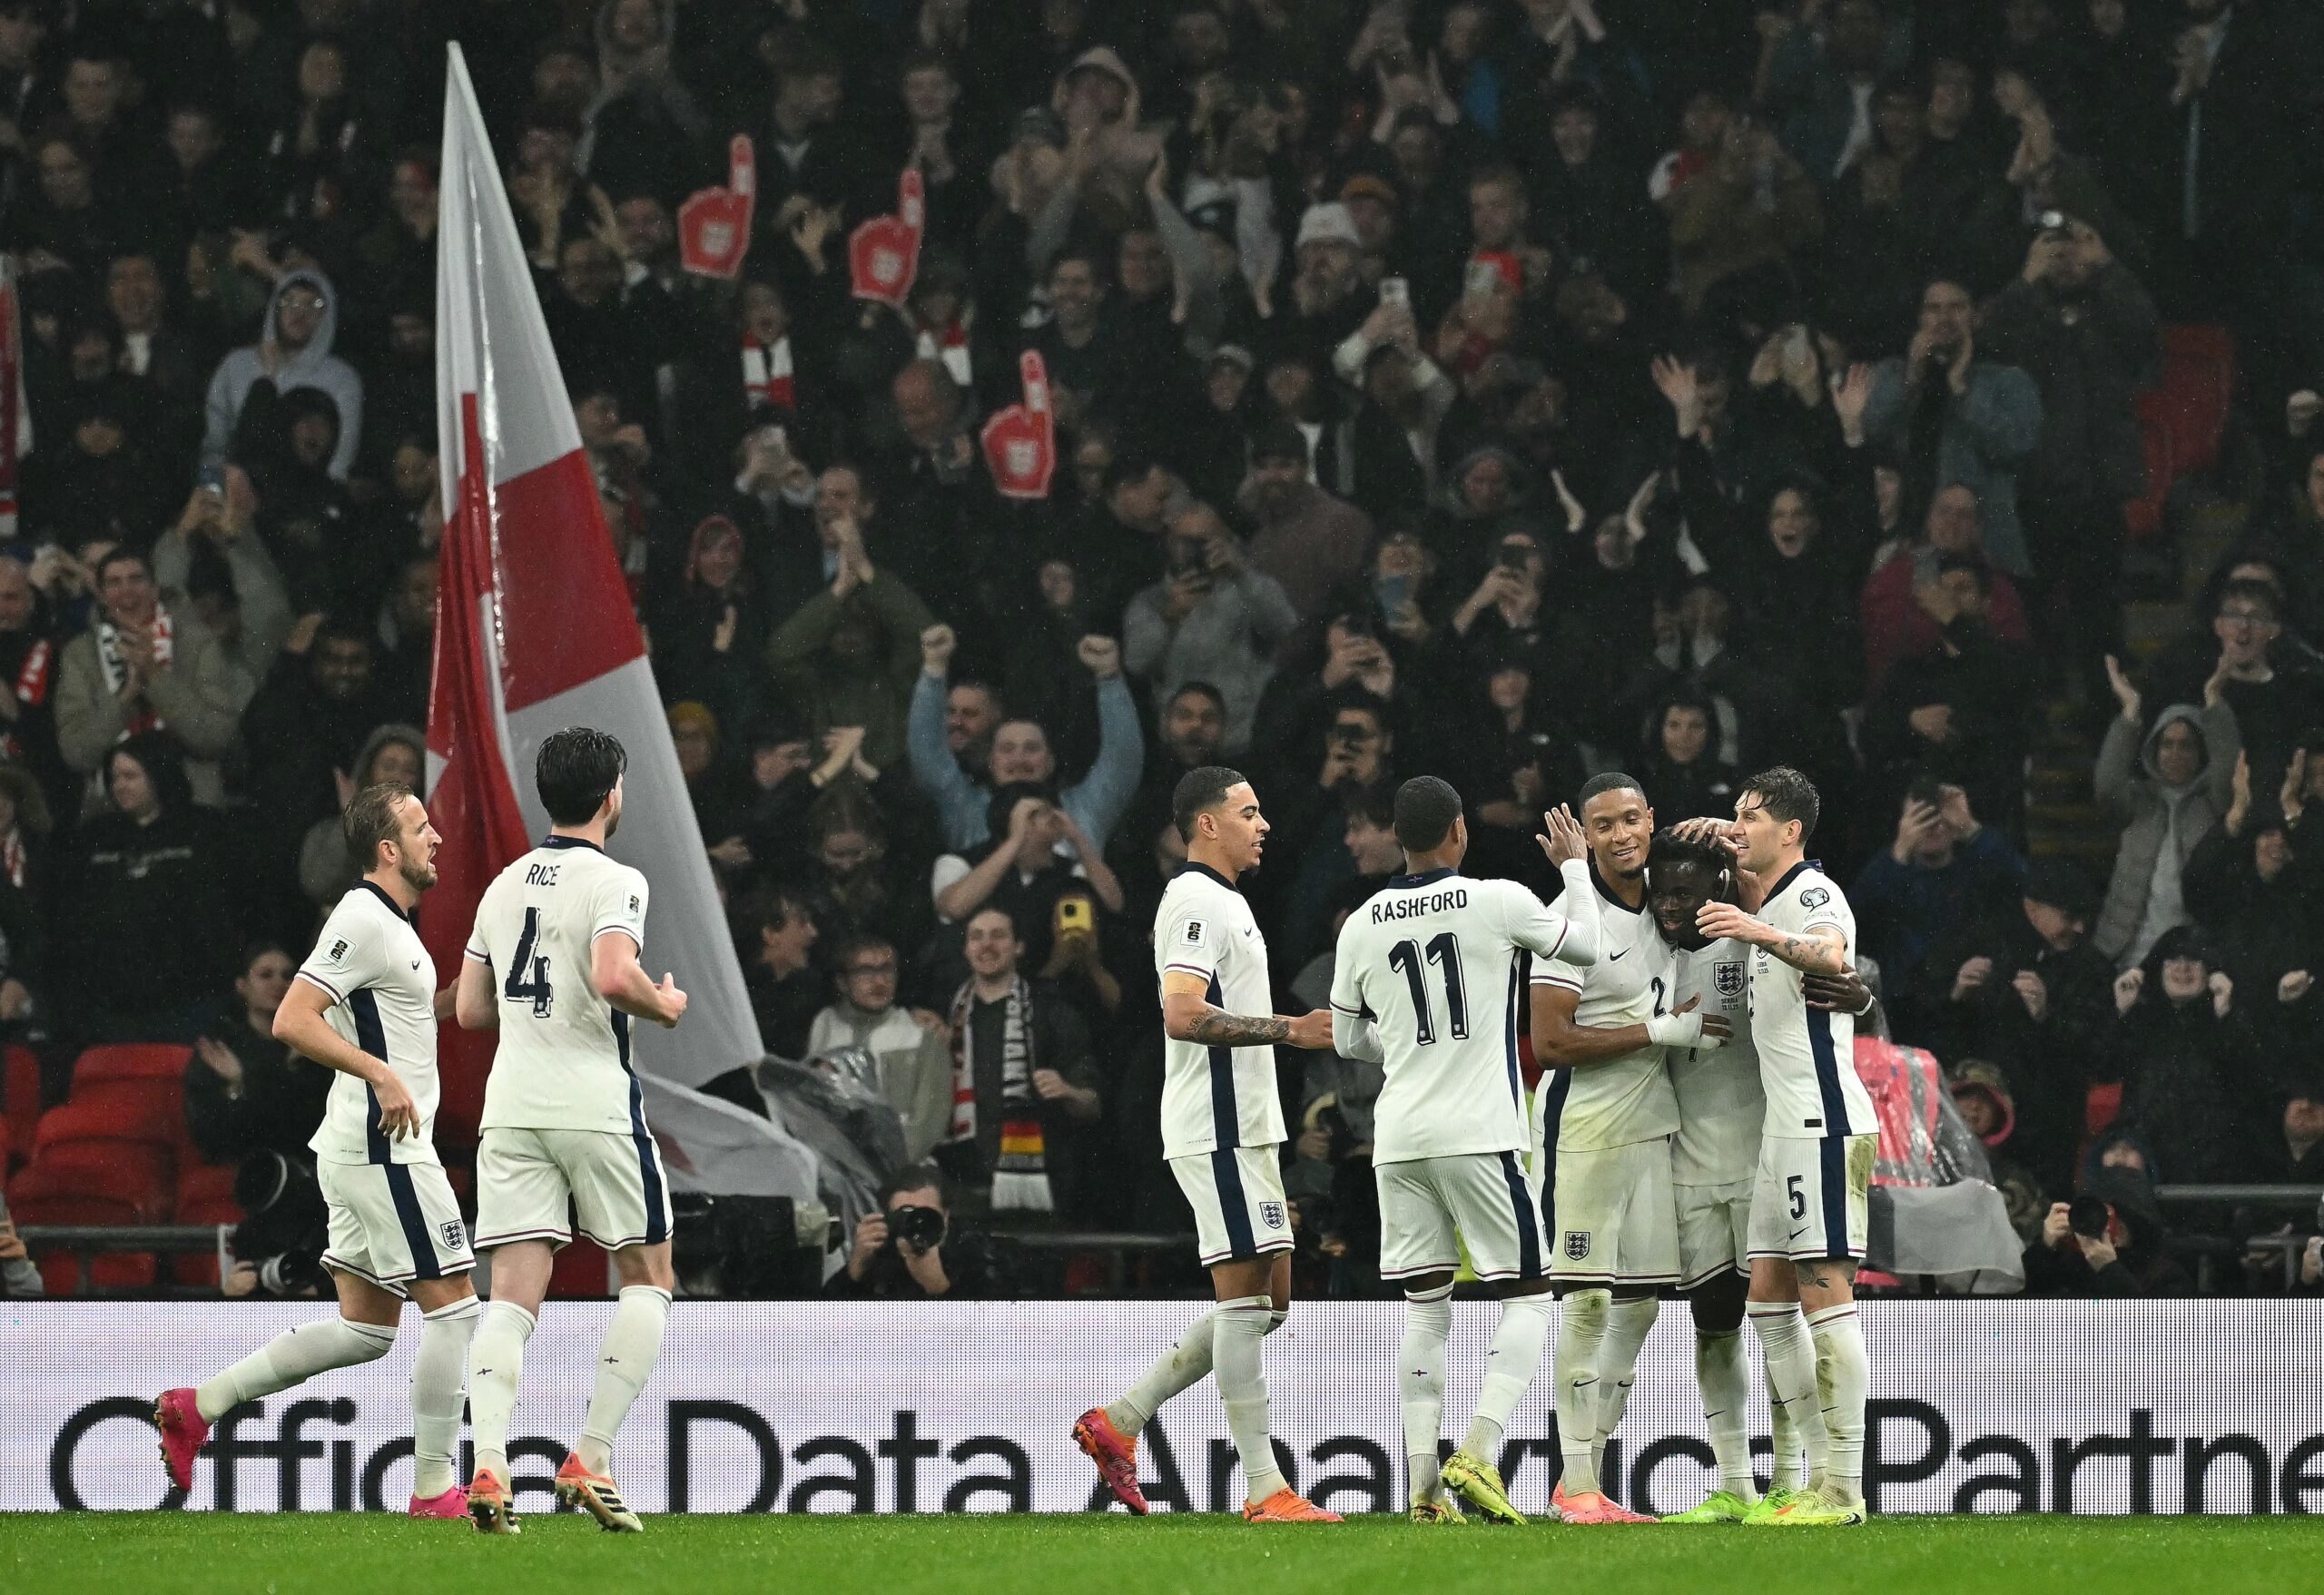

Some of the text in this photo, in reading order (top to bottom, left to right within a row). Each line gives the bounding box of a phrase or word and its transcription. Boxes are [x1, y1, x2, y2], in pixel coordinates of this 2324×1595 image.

[525, 863, 561, 886] RICE
[1372, 889, 1468, 925] RASHFORD
[504, 906, 554, 1019] 4
[1388, 931, 1470, 1046] 11
[1650, 976, 1667, 1019] 2
[1787, 1174, 1807, 1221] 5
[49, 1397, 606, 1512] Officia
[668, 1400, 1031, 1513] Data
